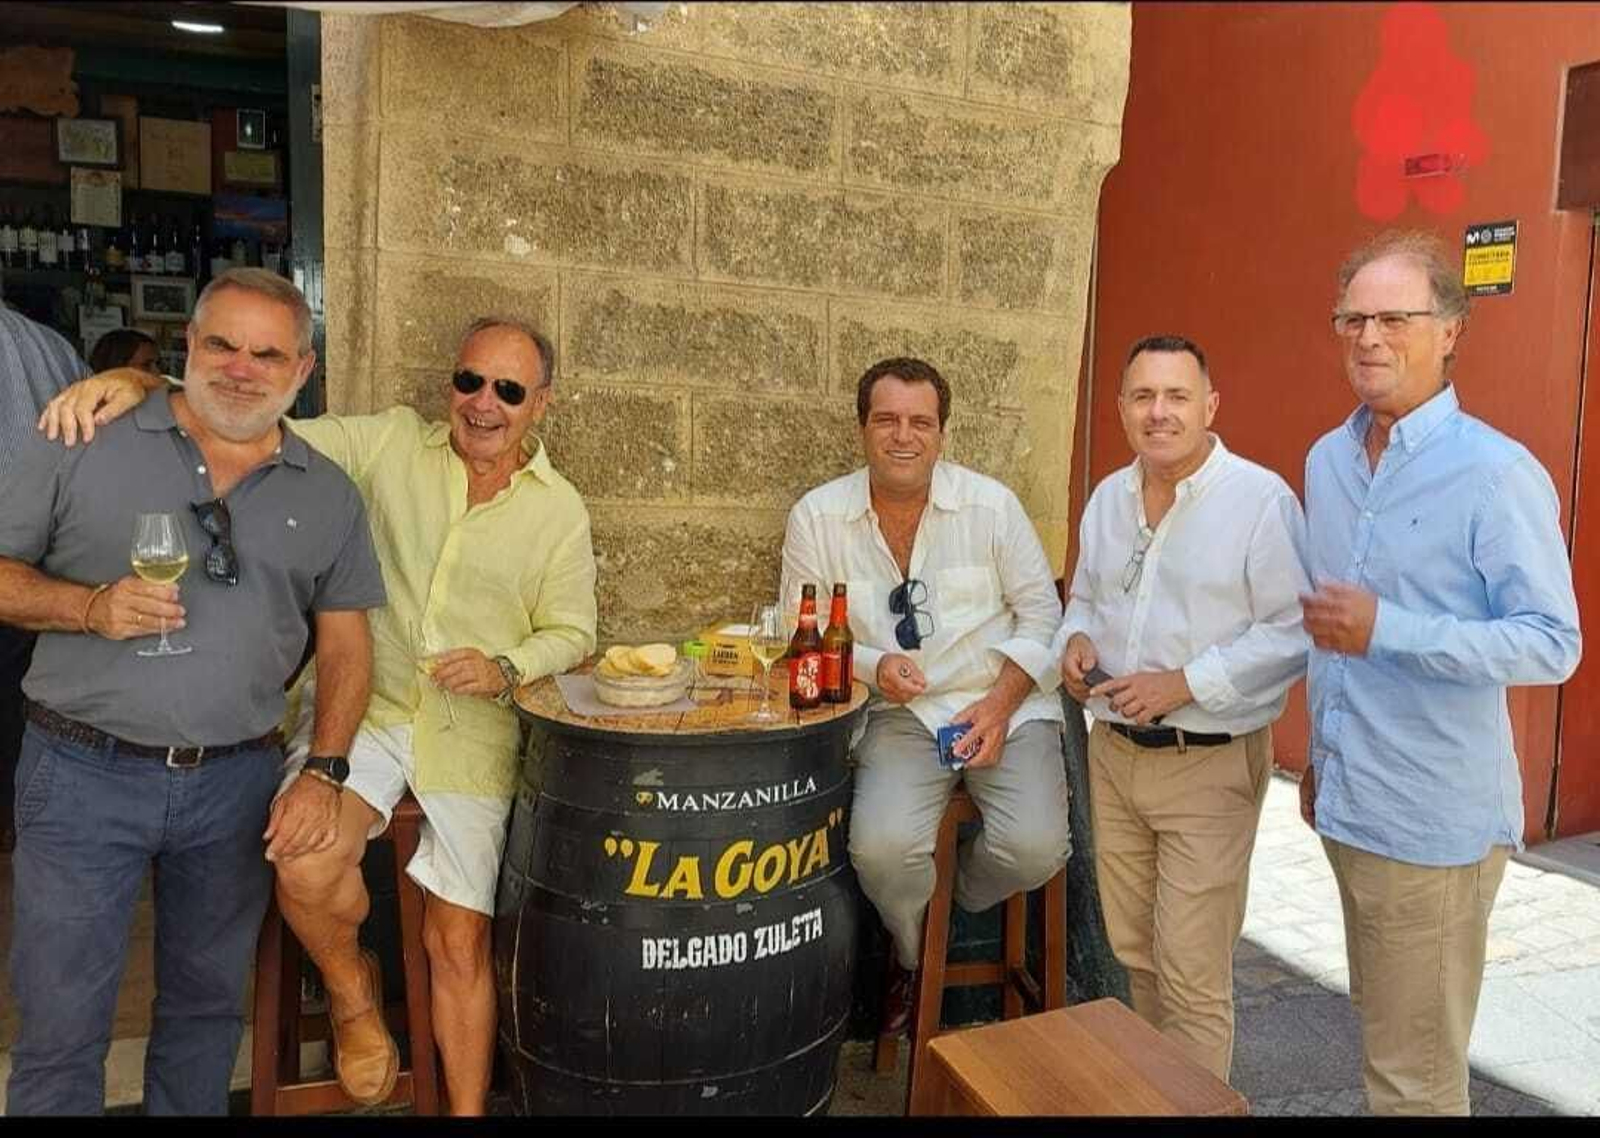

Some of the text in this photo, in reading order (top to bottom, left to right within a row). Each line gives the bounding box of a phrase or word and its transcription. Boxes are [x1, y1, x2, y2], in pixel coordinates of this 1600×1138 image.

[656, 776, 817, 811] MANZANILLA
[642, 907, 824, 970] DELGADO ZULETA
